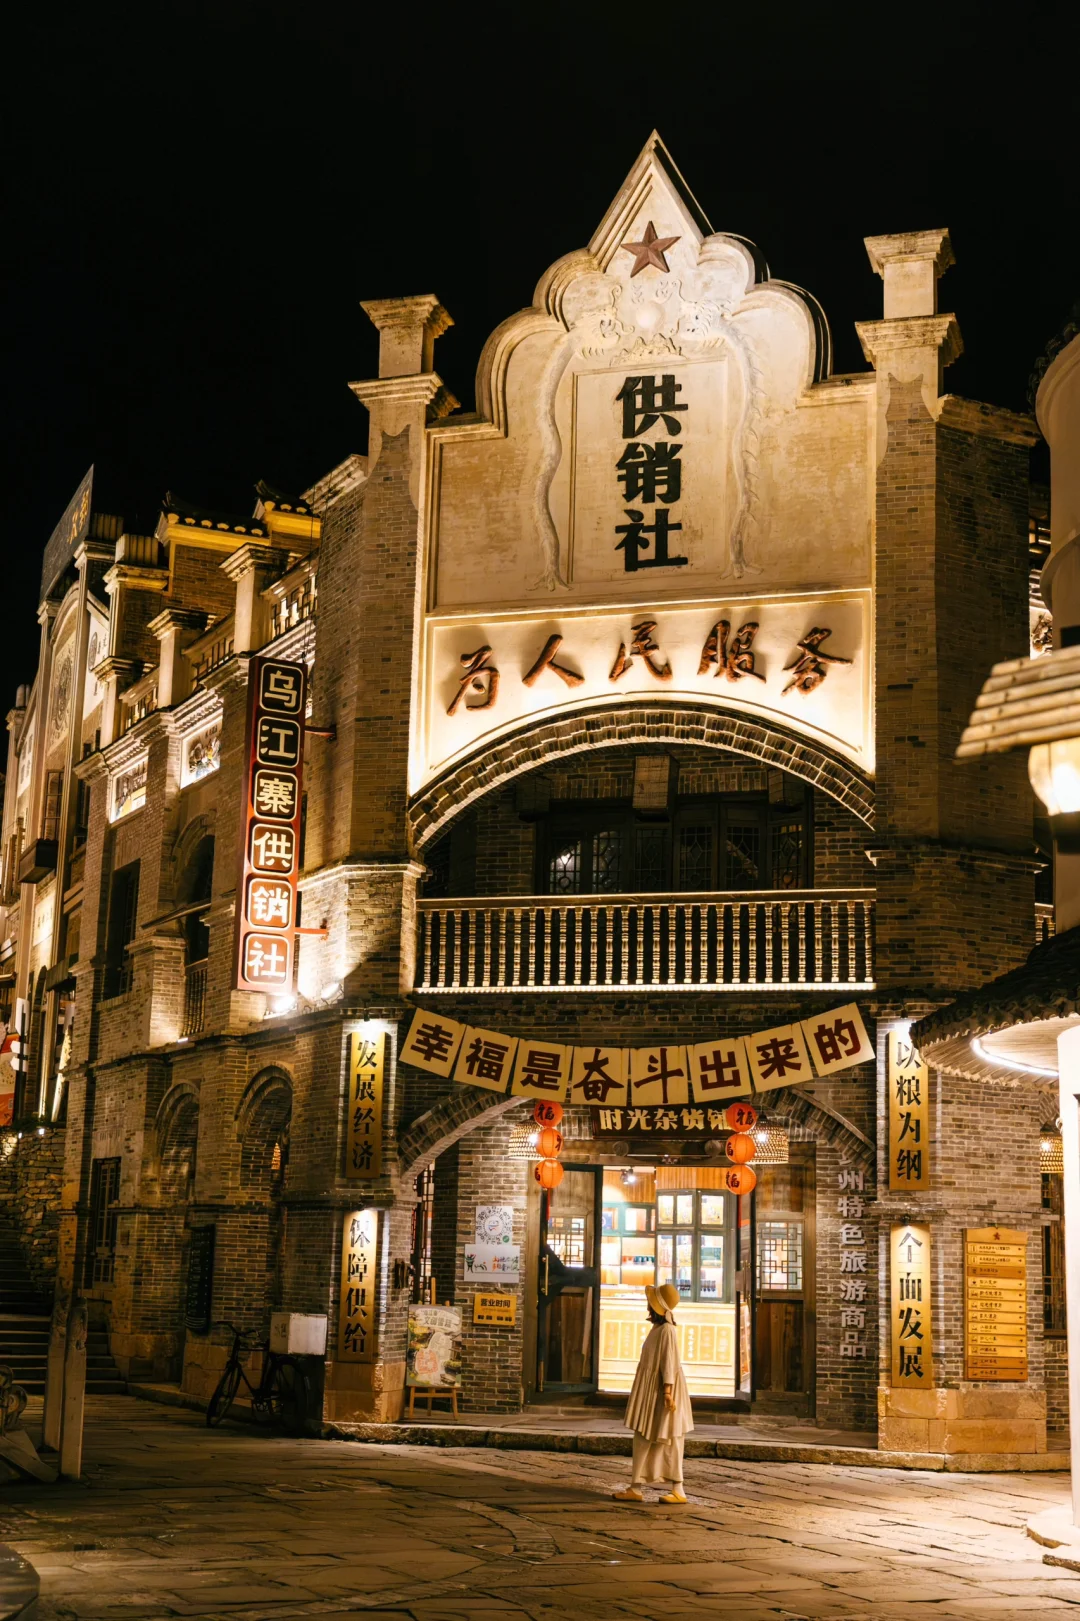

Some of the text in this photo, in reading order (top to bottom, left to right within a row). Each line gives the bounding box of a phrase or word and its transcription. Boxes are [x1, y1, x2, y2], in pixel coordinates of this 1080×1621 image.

[614, 374, 688, 572] 供销社
[446, 620, 853, 716] 为人民服务
[246, 670, 298, 979] 乌江寨供销社
[352, 1039, 379, 1170] 发展经济
[410, 1016, 862, 1104] 幸福是奋斗出来的
[599, 1108, 731, 1131] 时光杂货铺
[895, 1041, 922, 1181] 以粮为纲
[344, 1218, 371, 1355] 保障供给
[480, 1298, 511, 1308] 营业时间
[898, 1232, 924, 1378] 全面发展
